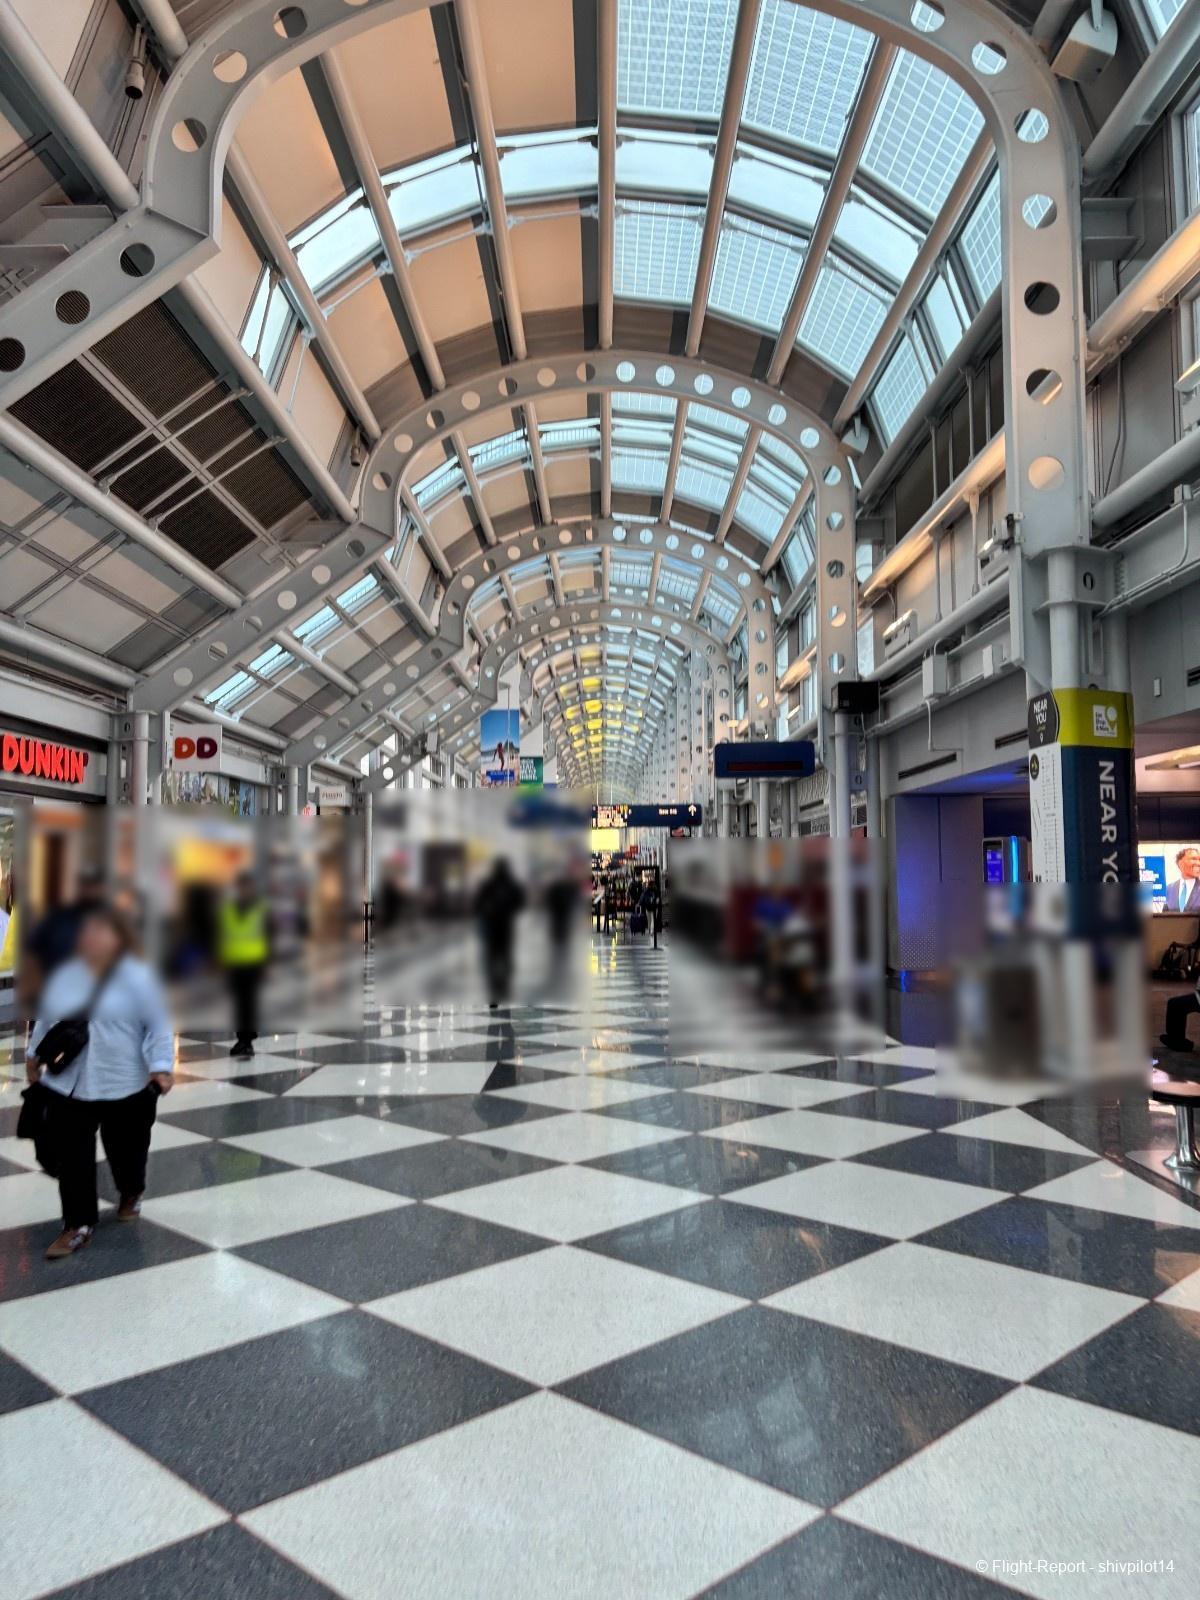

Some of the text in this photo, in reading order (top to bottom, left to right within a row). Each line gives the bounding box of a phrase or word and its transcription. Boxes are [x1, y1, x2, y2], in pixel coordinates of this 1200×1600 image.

[1034, 699, 1048, 714] NEAR
[1035, 713, 1047, 726] YOU
[3, 731, 89, 784] DUNKIN'
[174, 736, 218, 760] DD
[1099, 761, 1118, 843] NEAR
